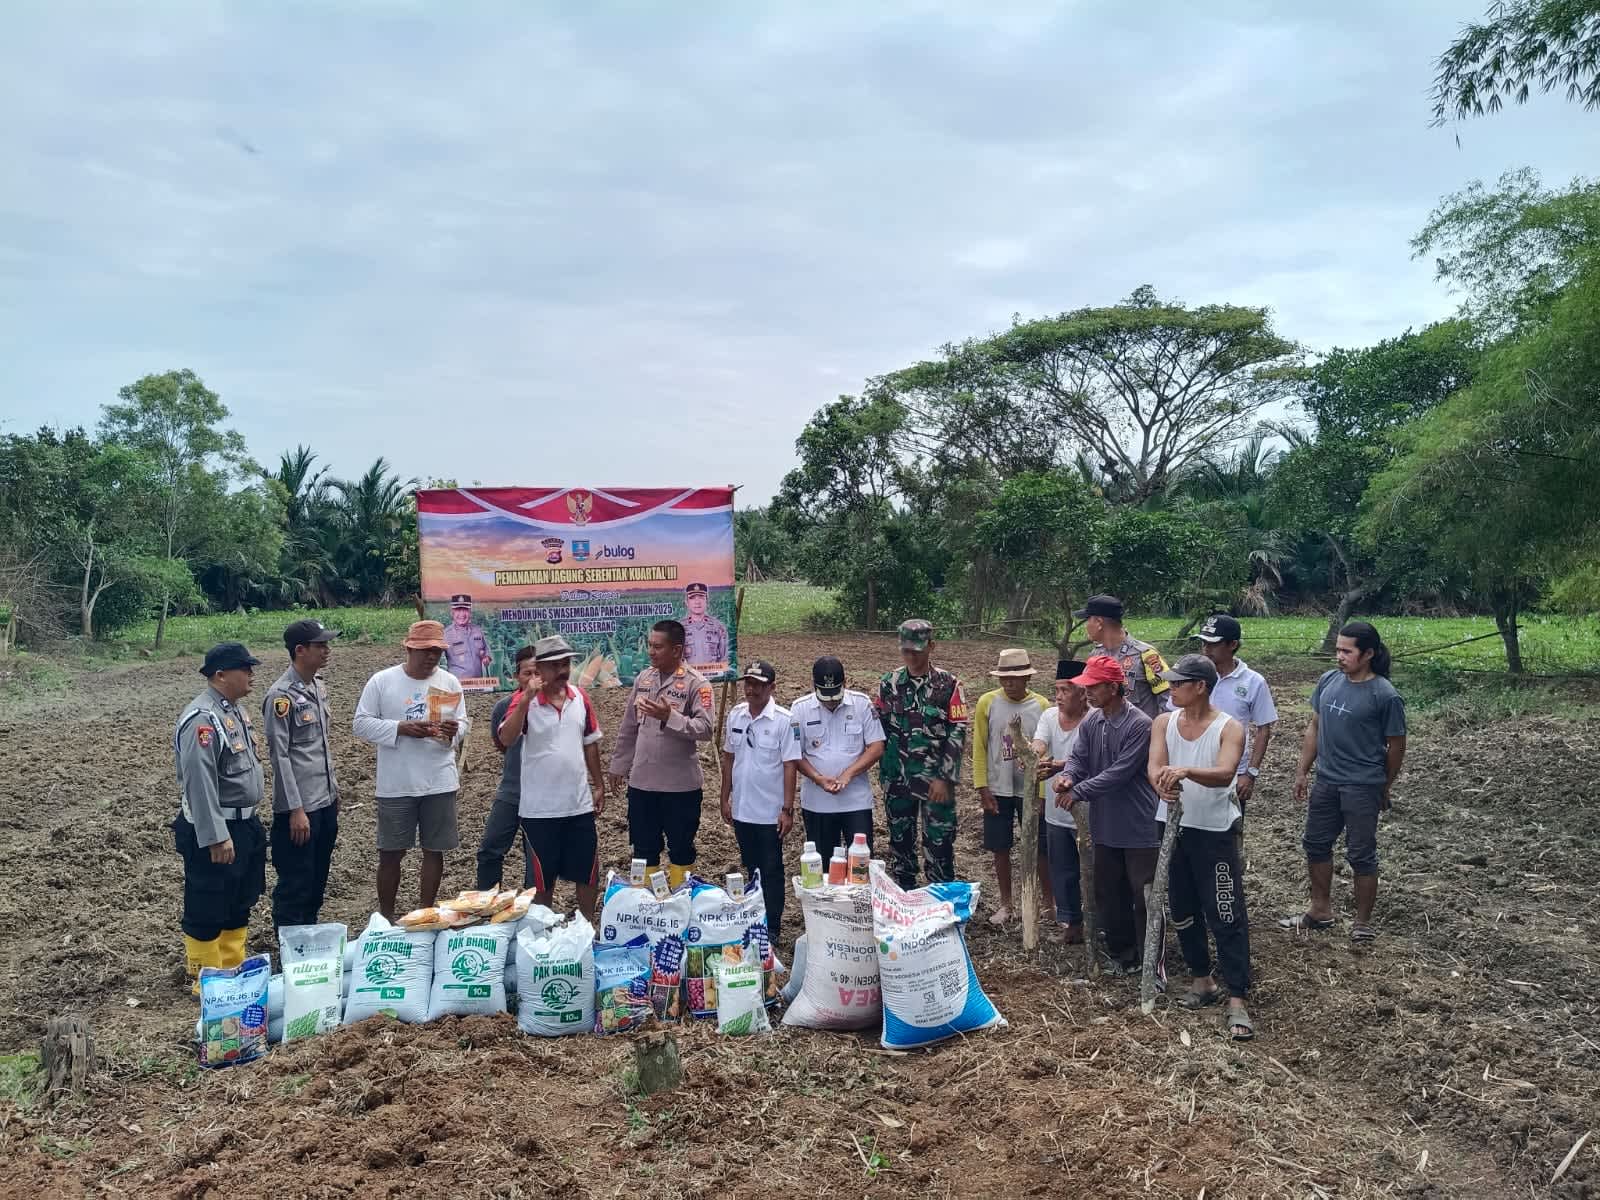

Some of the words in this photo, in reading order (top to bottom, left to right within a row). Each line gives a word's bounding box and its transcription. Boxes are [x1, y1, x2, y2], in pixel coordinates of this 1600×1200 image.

[604, 544, 635, 560] bulog
[495, 570, 550, 586] PENANAMAN
[551, 568, 585, 583] JAGUNG
[585, 567, 628, 582] SERENTAK
[629, 566, 667, 581] KUARTAL
[668, 565, 677, 580] III
[501, 609, 548, 621] MENDUKUNG
[549, 607, 599, 620] SWASEMBADA
[600, 605, 629, 617] PANGAN
[630, 604, 653, 616] TAHUN
[654, 603, 673, 615] 2025
[560, 622, 587, 633] POLRES
[588, 620, 616, 632] SERANG
[667, 690, 688, 699] POLRI
[1215, 862, 1235, 924] adidas
[616, 912, 640, 925] NPK
[643, 915, 679, 929] 16.16.16
[698, 913, 722, 923] NPK
[726, 909, 759, 921] 16.16.16
[605, 929, 614, 937] 20
[362, 941, 380, 959] PAK
[381, 941, 413, 960] BHABIN
[447, 936, 465, 954] PAK
[466, 936, 497, 956] BHABIN
[533, 965, 550, 984] PAK
[552, 961, 583, 980] BHABIN
[839, 974, 850, 984] 46
[204, 996, 223, 1005] NPK
[226, 990, 260, 1002] 16.16.16
[386, 989, 396, 998] 10
[473, 987, 483, 995] 10
[565, 1013, 575, 1021] 10
